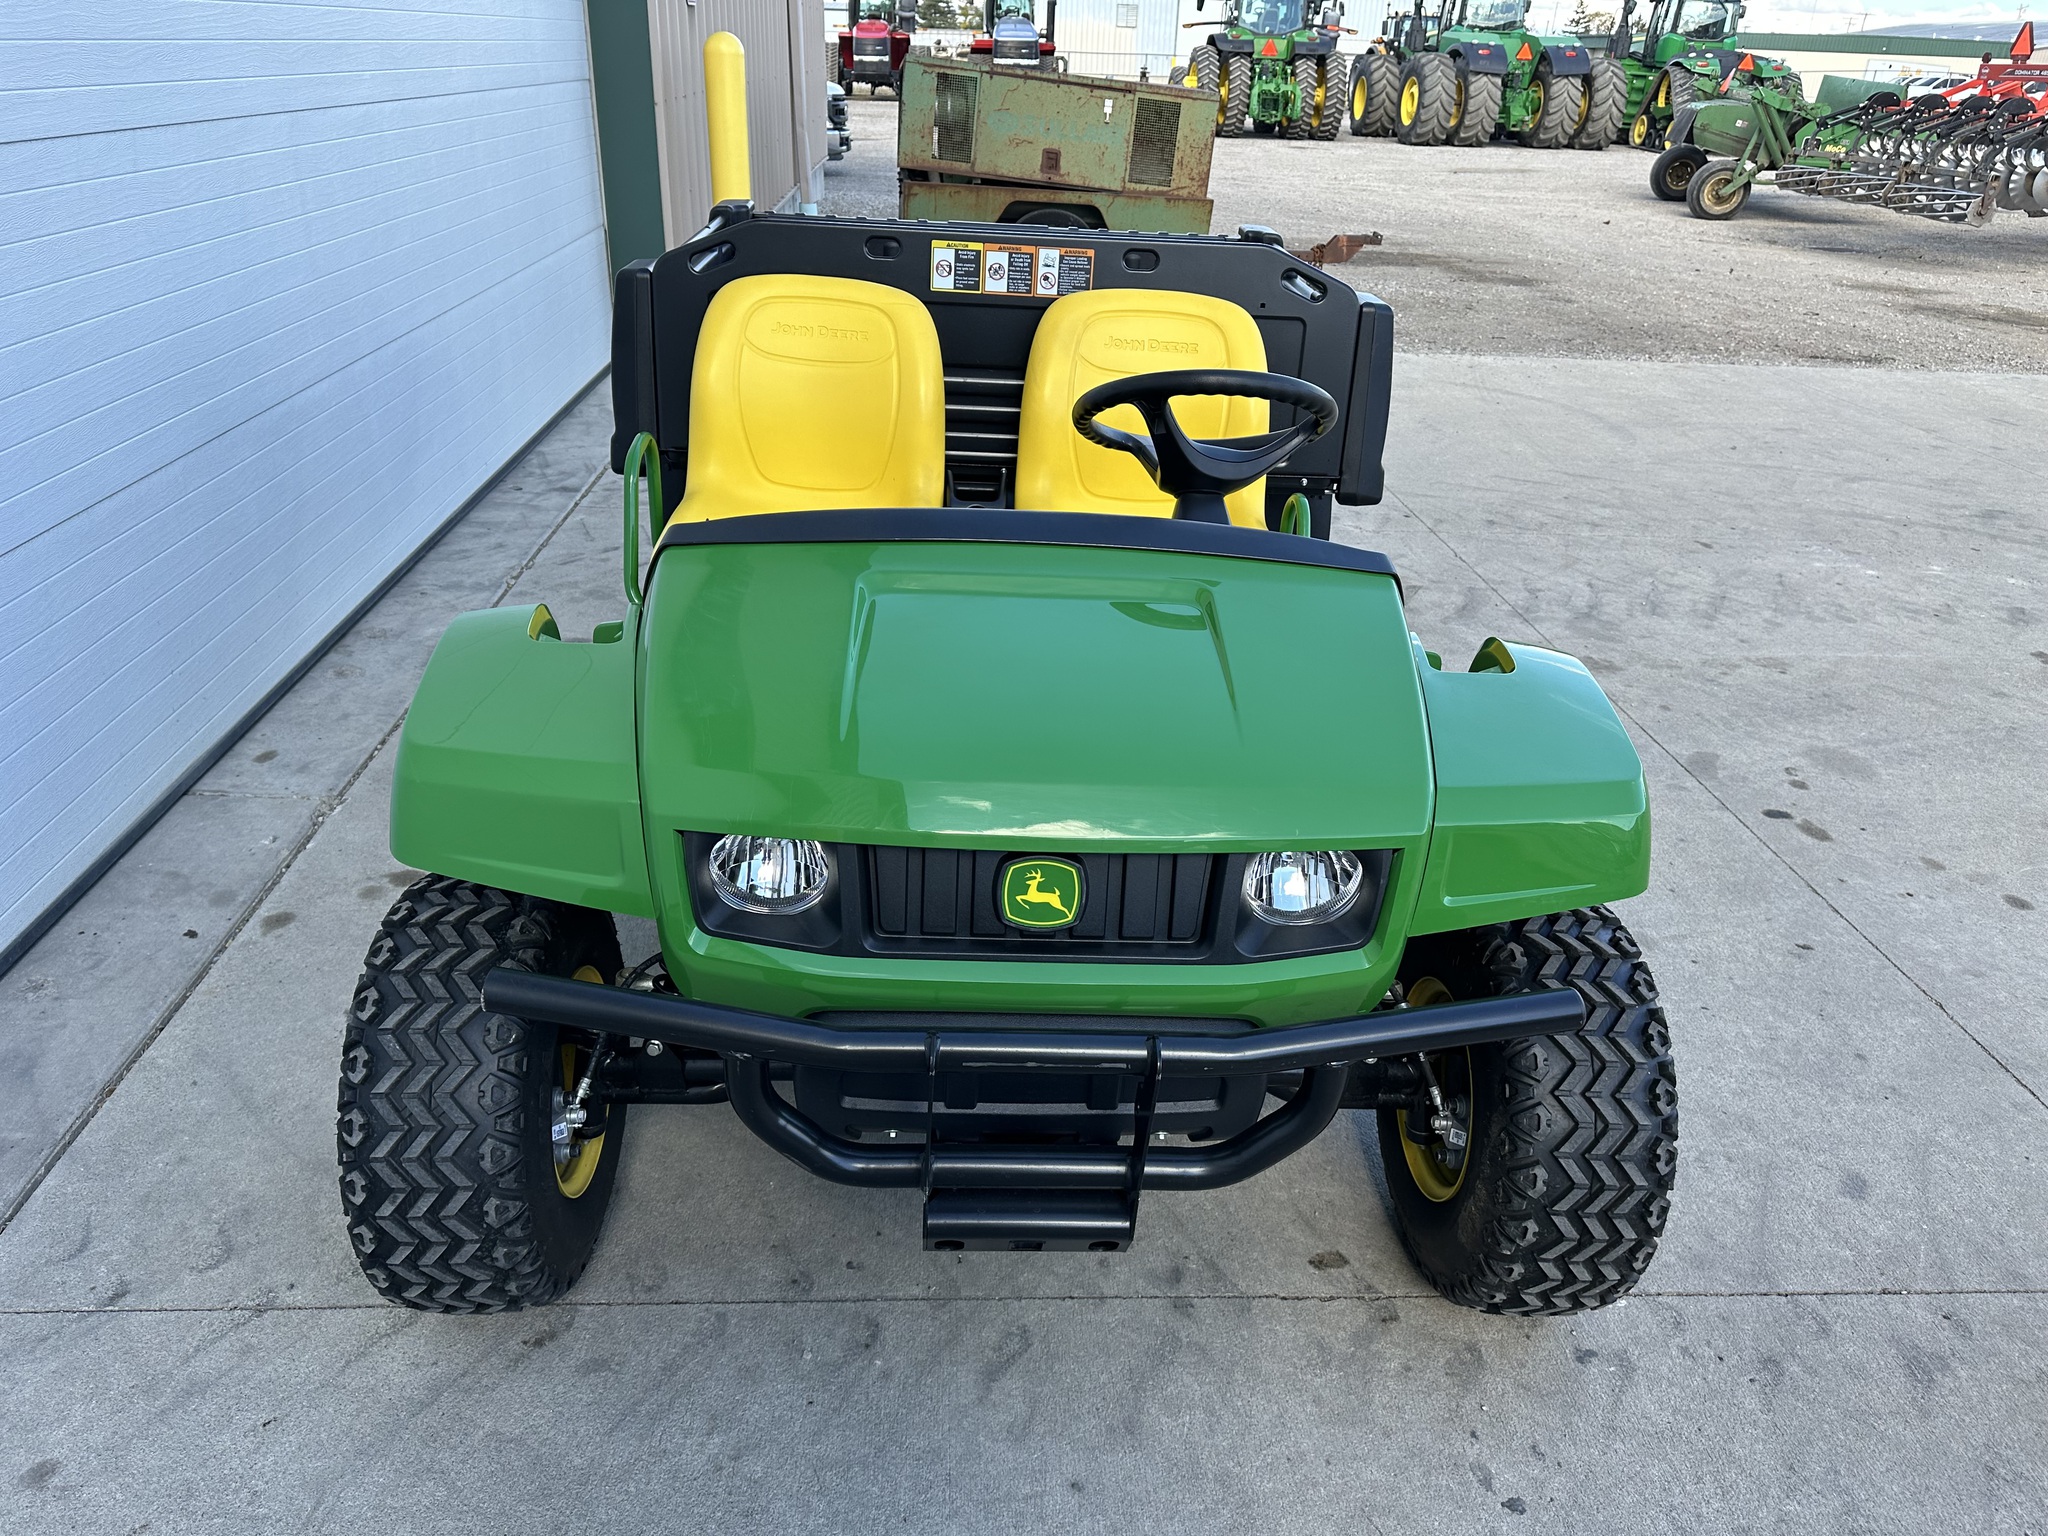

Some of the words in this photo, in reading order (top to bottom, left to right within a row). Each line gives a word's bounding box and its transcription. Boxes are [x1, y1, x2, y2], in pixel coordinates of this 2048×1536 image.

[1825, 144, 1847, 153] MoCo
[771, 321, 814, 338] JOHN
[817, 324, 869, 342] DEERE
[1104, 335, 1145, 352] JOHN
[1147, 338, 1199, 354] DEERE
